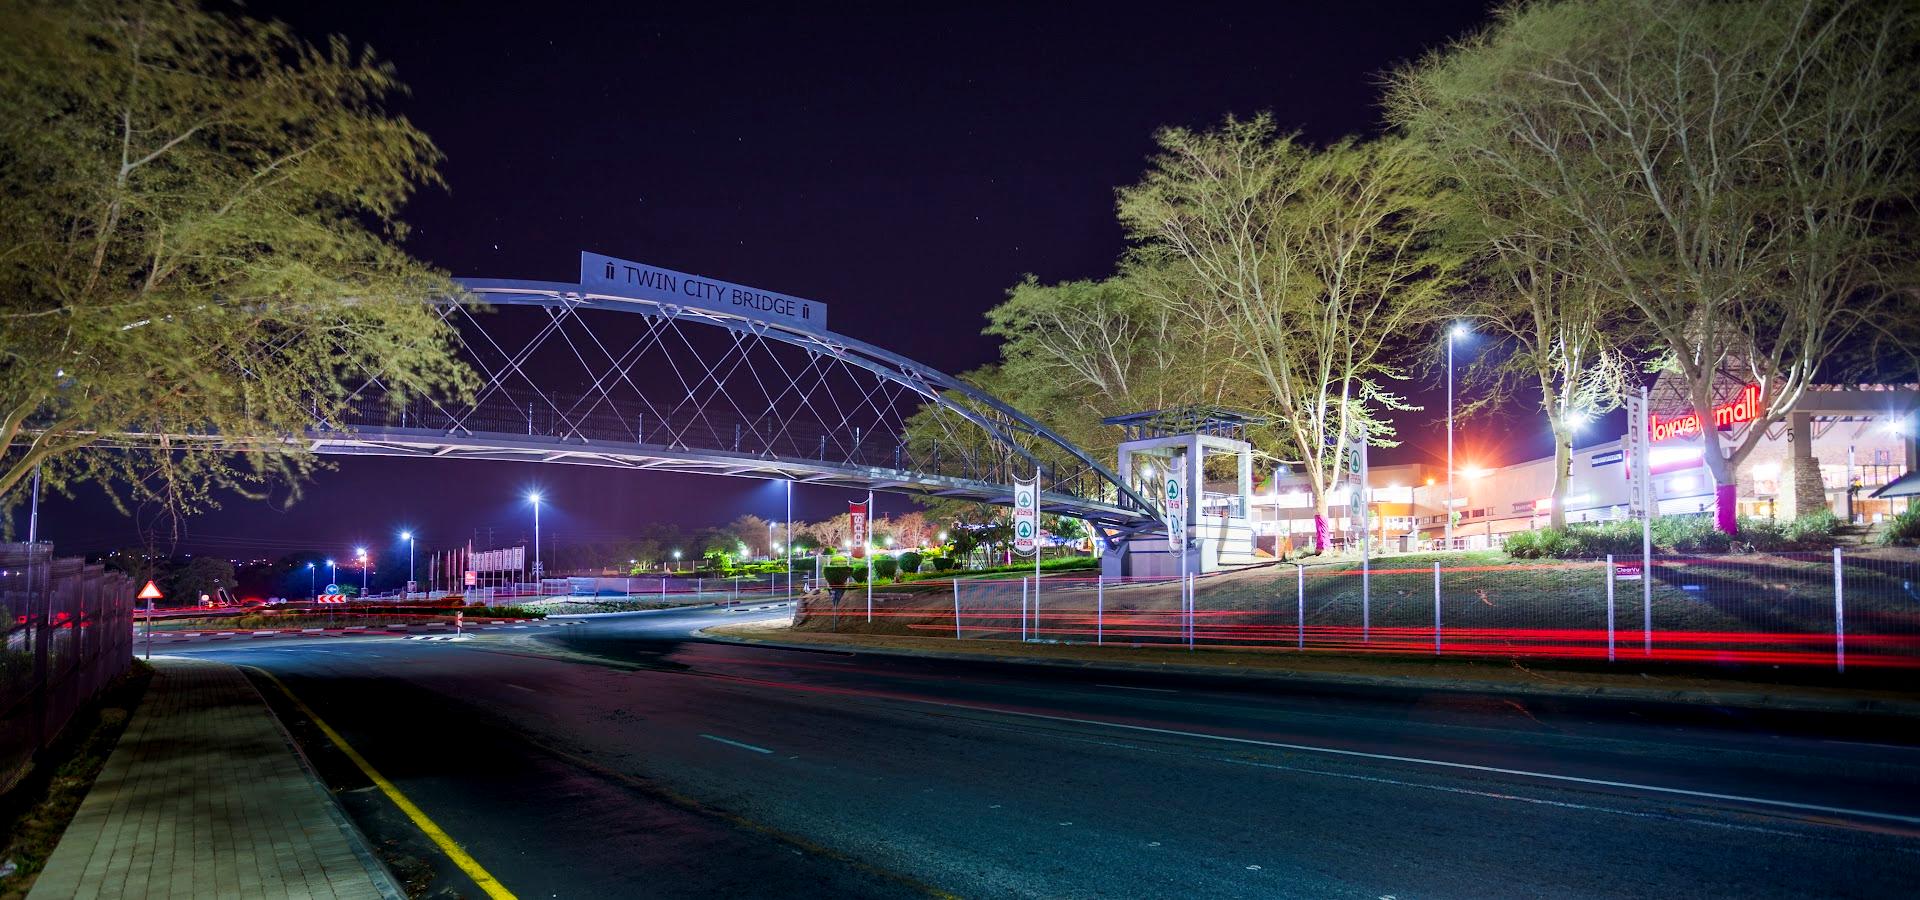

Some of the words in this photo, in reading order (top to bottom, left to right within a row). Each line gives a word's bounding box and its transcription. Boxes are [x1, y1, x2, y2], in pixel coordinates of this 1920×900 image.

[623, 265, 676, 293] TWIN
[683, 279, 726, 302] CITY
[732, 289, 795, 316] BRIDGE
[1651, 413, 1701, 442] lowvel
[1716, 386, 1756, 427] mall
[1787, 428, 1795, 443] 5
